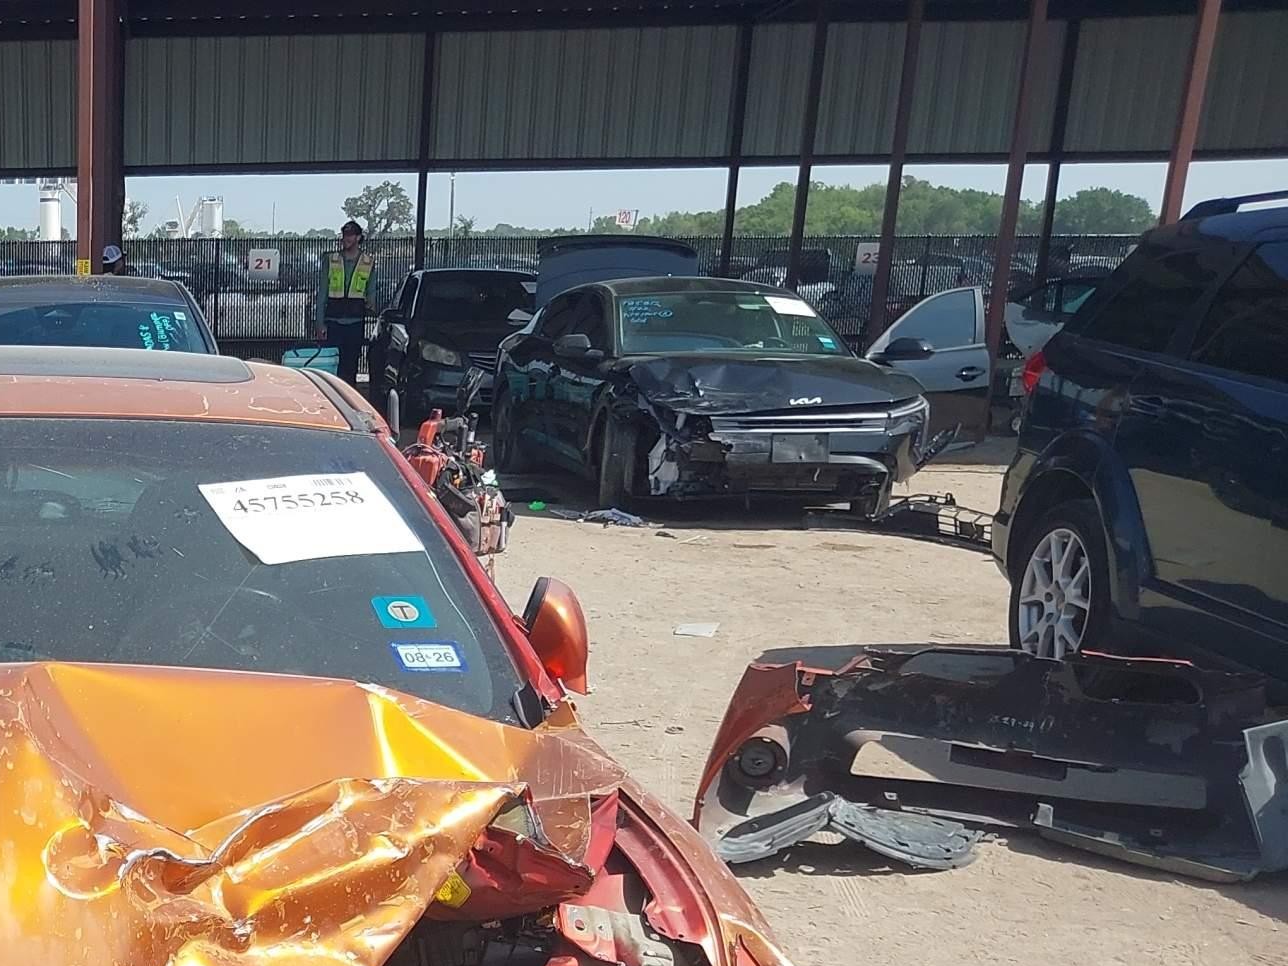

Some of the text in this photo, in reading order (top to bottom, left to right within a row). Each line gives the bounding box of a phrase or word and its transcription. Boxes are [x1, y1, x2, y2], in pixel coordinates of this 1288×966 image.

[254, 258, 272, 270] 21
[233, 490, 365, 513] 45755258
[392, 605, 411, 620] T
[404, 652, 454, 663] 08 26
